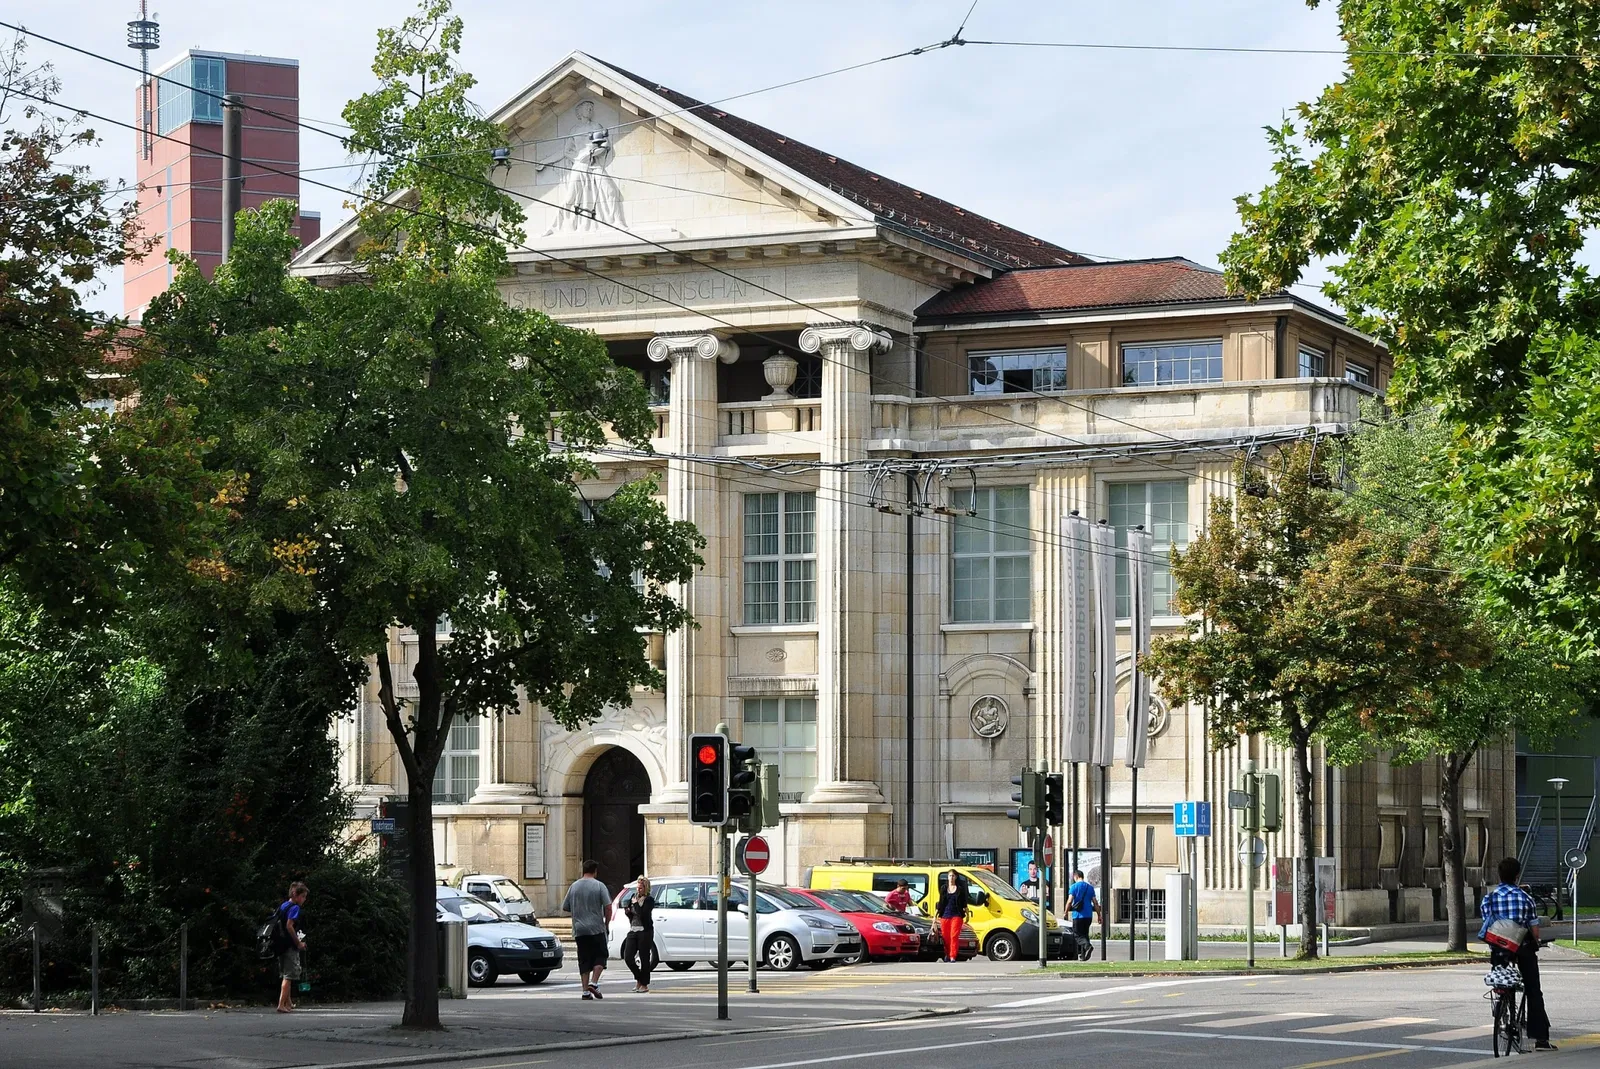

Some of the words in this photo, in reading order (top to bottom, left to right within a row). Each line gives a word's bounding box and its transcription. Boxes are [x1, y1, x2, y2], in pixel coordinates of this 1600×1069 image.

[543, 287, 588, 309] UND
[596, 275, 771, 306] WISSENSCHAFT
[1076, 530, 1086, 735] Studienbibliothek
